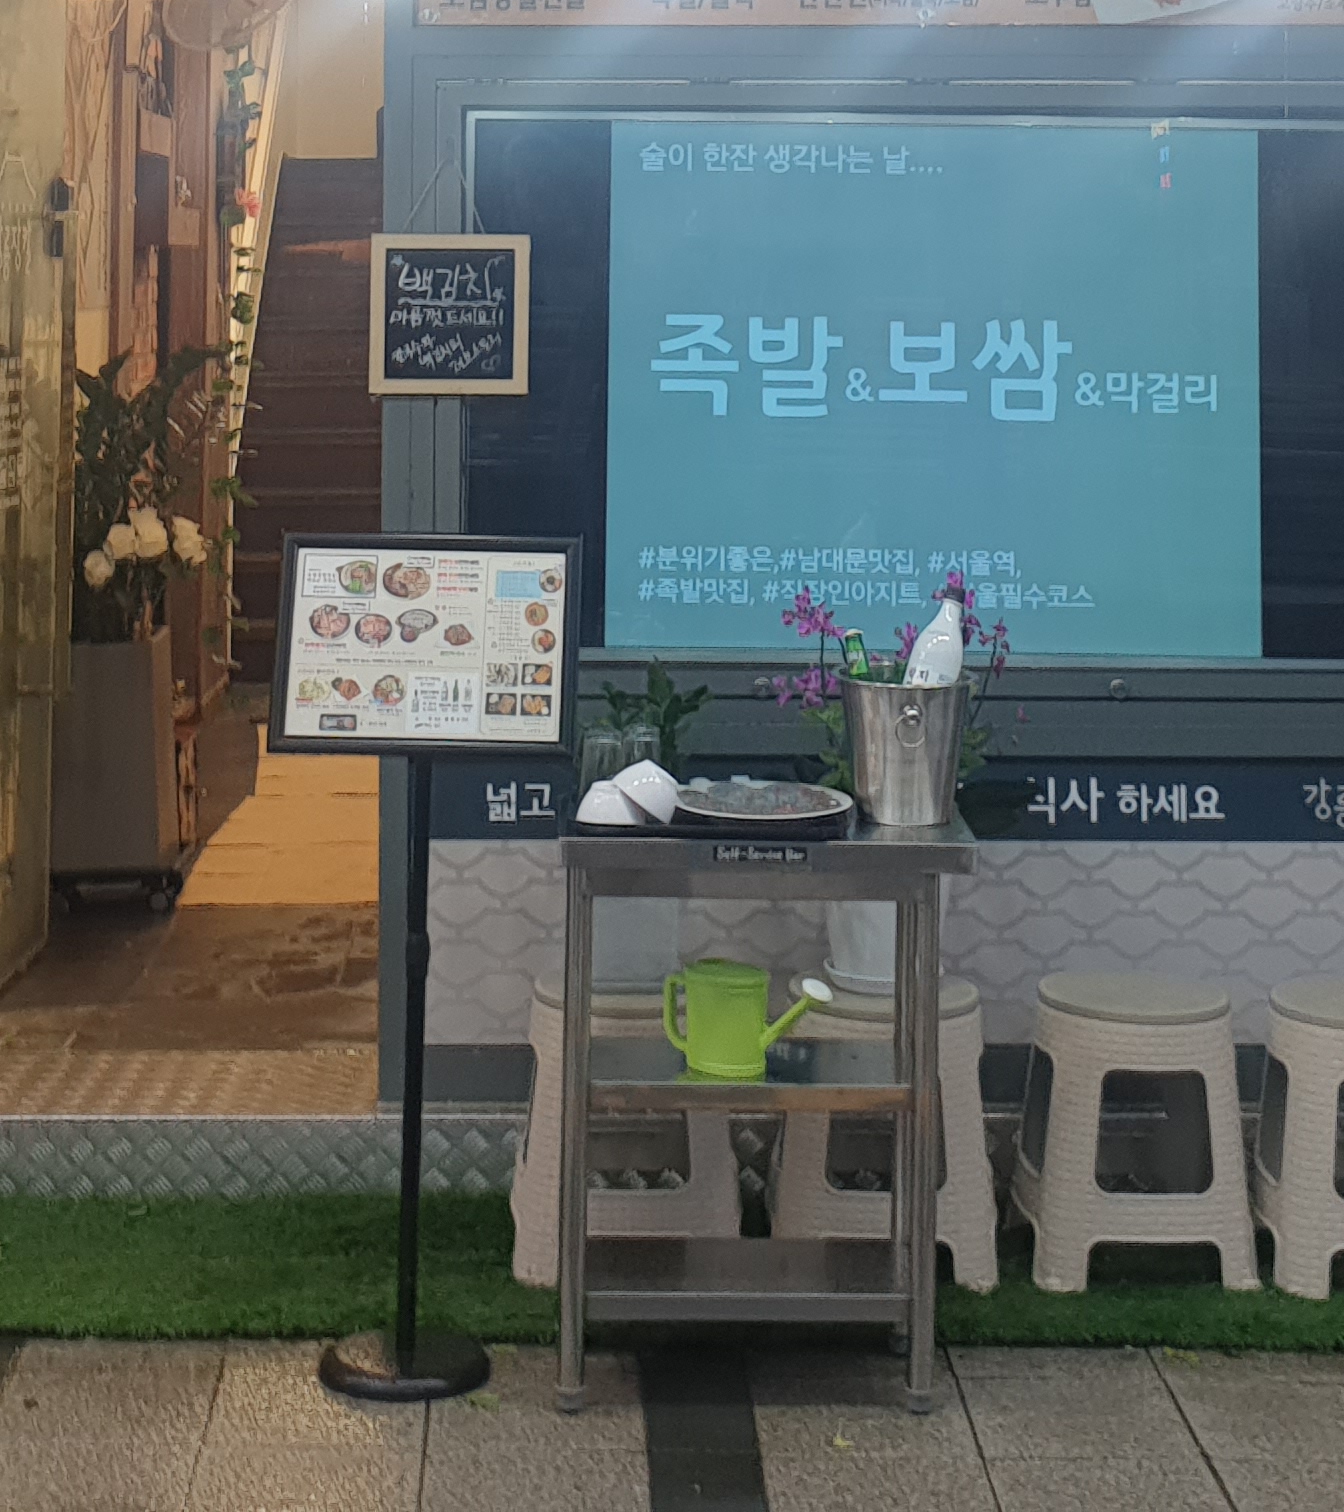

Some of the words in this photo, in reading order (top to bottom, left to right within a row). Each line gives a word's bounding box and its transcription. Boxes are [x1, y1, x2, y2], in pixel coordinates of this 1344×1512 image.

[639, 143, 695, 171] 술이
[703, 142, 757, 172] 한잔
[763, 144, 875, 174] 생각나는
[936, 582, 1095, 610] 울필수코스
[485, 780, 556, 823] 넓고
[1116, 782, 1226, 824] 하세요
